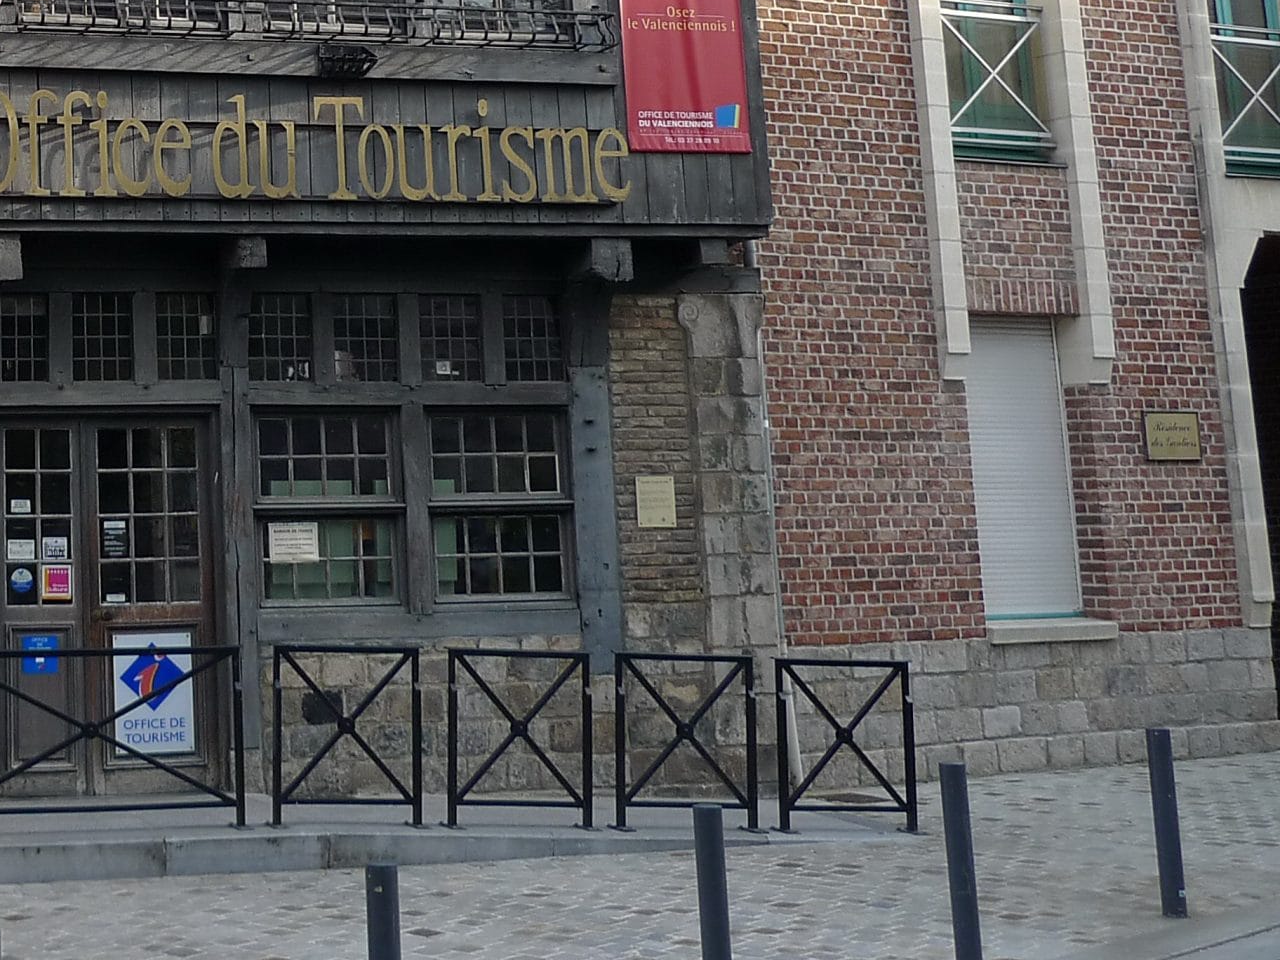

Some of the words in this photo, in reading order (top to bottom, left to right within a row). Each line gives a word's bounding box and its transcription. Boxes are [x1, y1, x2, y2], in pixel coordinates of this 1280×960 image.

[666, 5, 695, 18] Osez
[627, 17, 638, 29] le
[641, 18, 727, 31] Valenciennois
[638, 111, 662, 119] OFFICE
[663, 111, 674, 119] DE
[638, 119, 651, 127] DU
[653, 120, 714, 128] VALENCIENNOIS
[212, 93, 299, 200] du
[313, 95, 632, 204] Tourisme
[123, 719, 166, 730] OFFICE
[170, 717, 186, 728] DE
[125, 731, 186, 744] TOURISME
